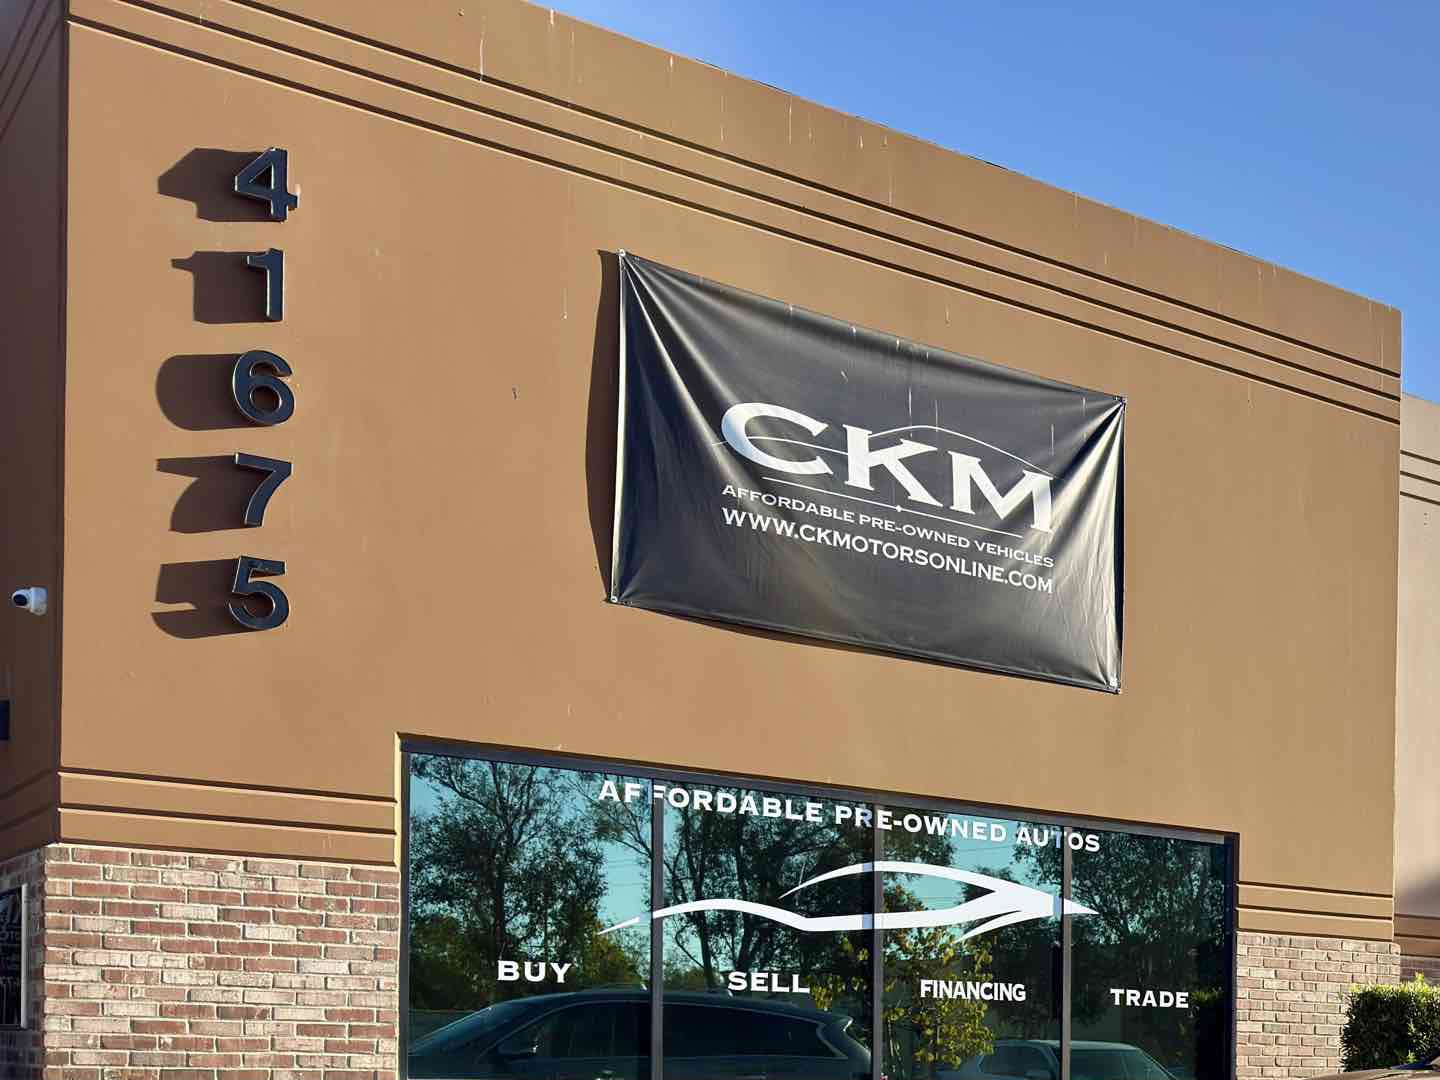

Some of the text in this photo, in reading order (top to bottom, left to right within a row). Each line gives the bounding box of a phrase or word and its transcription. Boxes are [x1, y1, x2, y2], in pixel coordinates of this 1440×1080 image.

[228, 146, 299, 632] 41675
[721, 402, 1054, 533] CKM
[721, 484, 1055, 568] AFFORDABLE PRE-OWNED VEHICLES
[722, 507, 1054, 594] WWW.CKMOTORSONLINE.COM
[598, 779, 1101, 852] AFFORDABLE PRE-OWNED AUTOS
[496, 959, 572, 984] BUY
[727, 971, 810, 994] SELL
[920, 979, 1027, 1002] FINANCING
[1110, 988, 1190, 1009] TRADE
